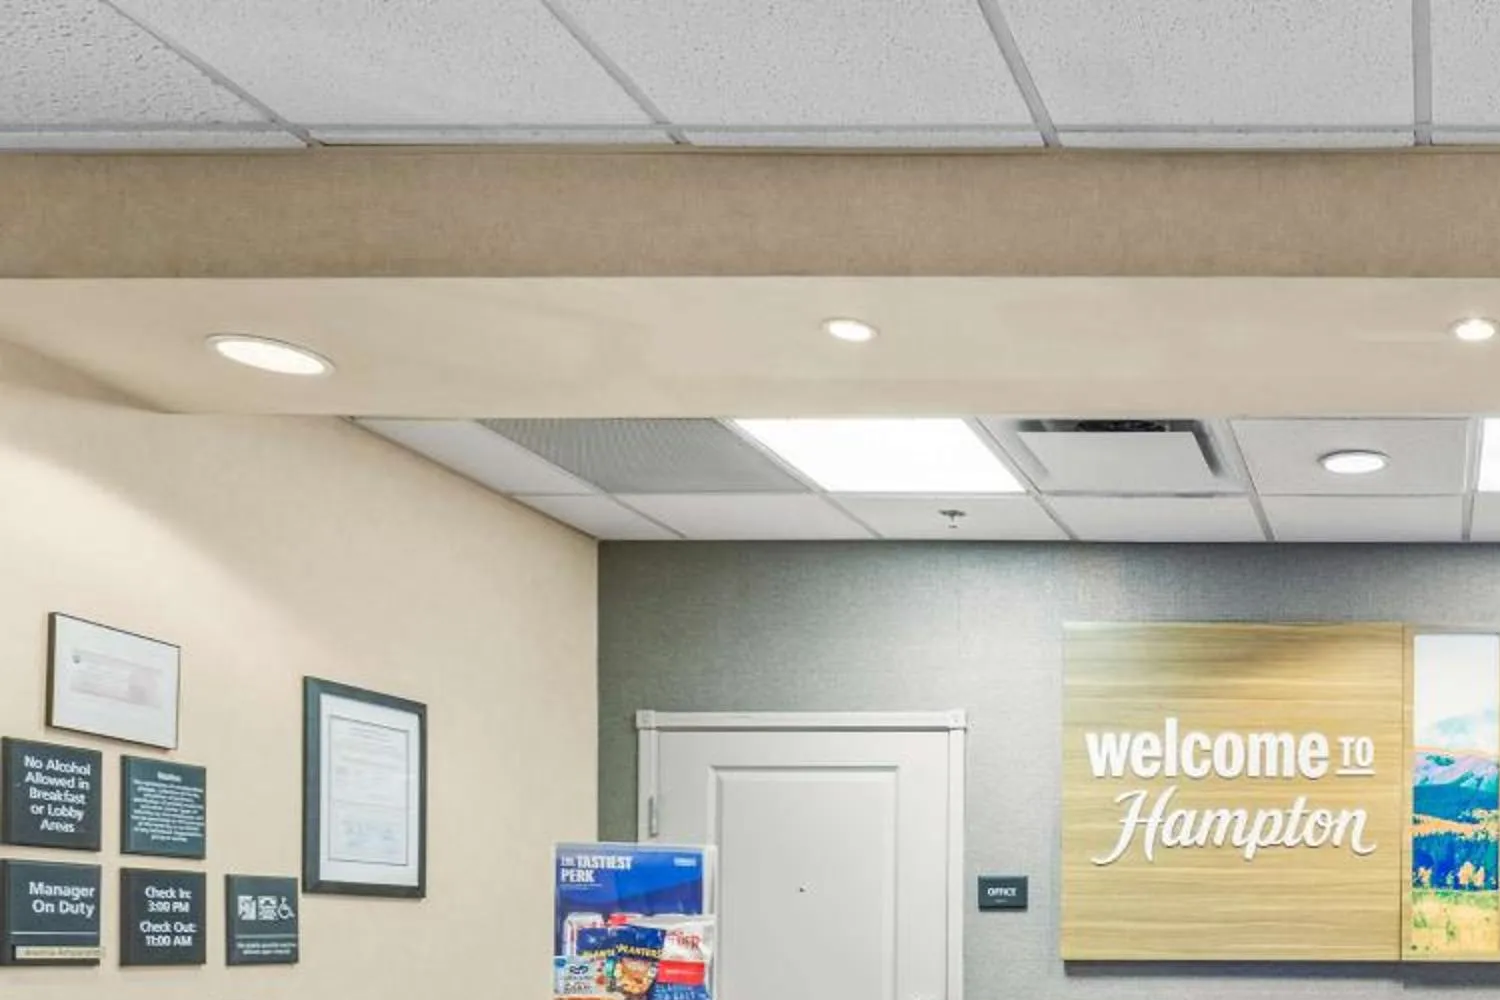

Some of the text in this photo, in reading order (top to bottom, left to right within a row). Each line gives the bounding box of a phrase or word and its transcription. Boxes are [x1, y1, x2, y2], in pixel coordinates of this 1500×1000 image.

[1085, 717, 1375, 779] welcome TO
[24, 755, 91, 776] No Alcohol
[25, 772, 90, 790] Allowed in
[29, 787, 86, 804] Breakfast
[30, 804, 84, 821] or Lobby
[40, 819, 75, 832] Areas
[1091, 785, 1377, 866] Hampton
[577, 856, 633, 870] TASTIEST
[561, 870, 595, 883] PERK
[28, 881, 95, 900] Manager
[145, 887, 192, 899] Check In:
[32, 899, 95, 919] On Duty
[148, 902, 189, 912] 3:00 PM
[140, 921, 197, 933] Check Out:
[146, 936, 193, 947] 11:00 AM
